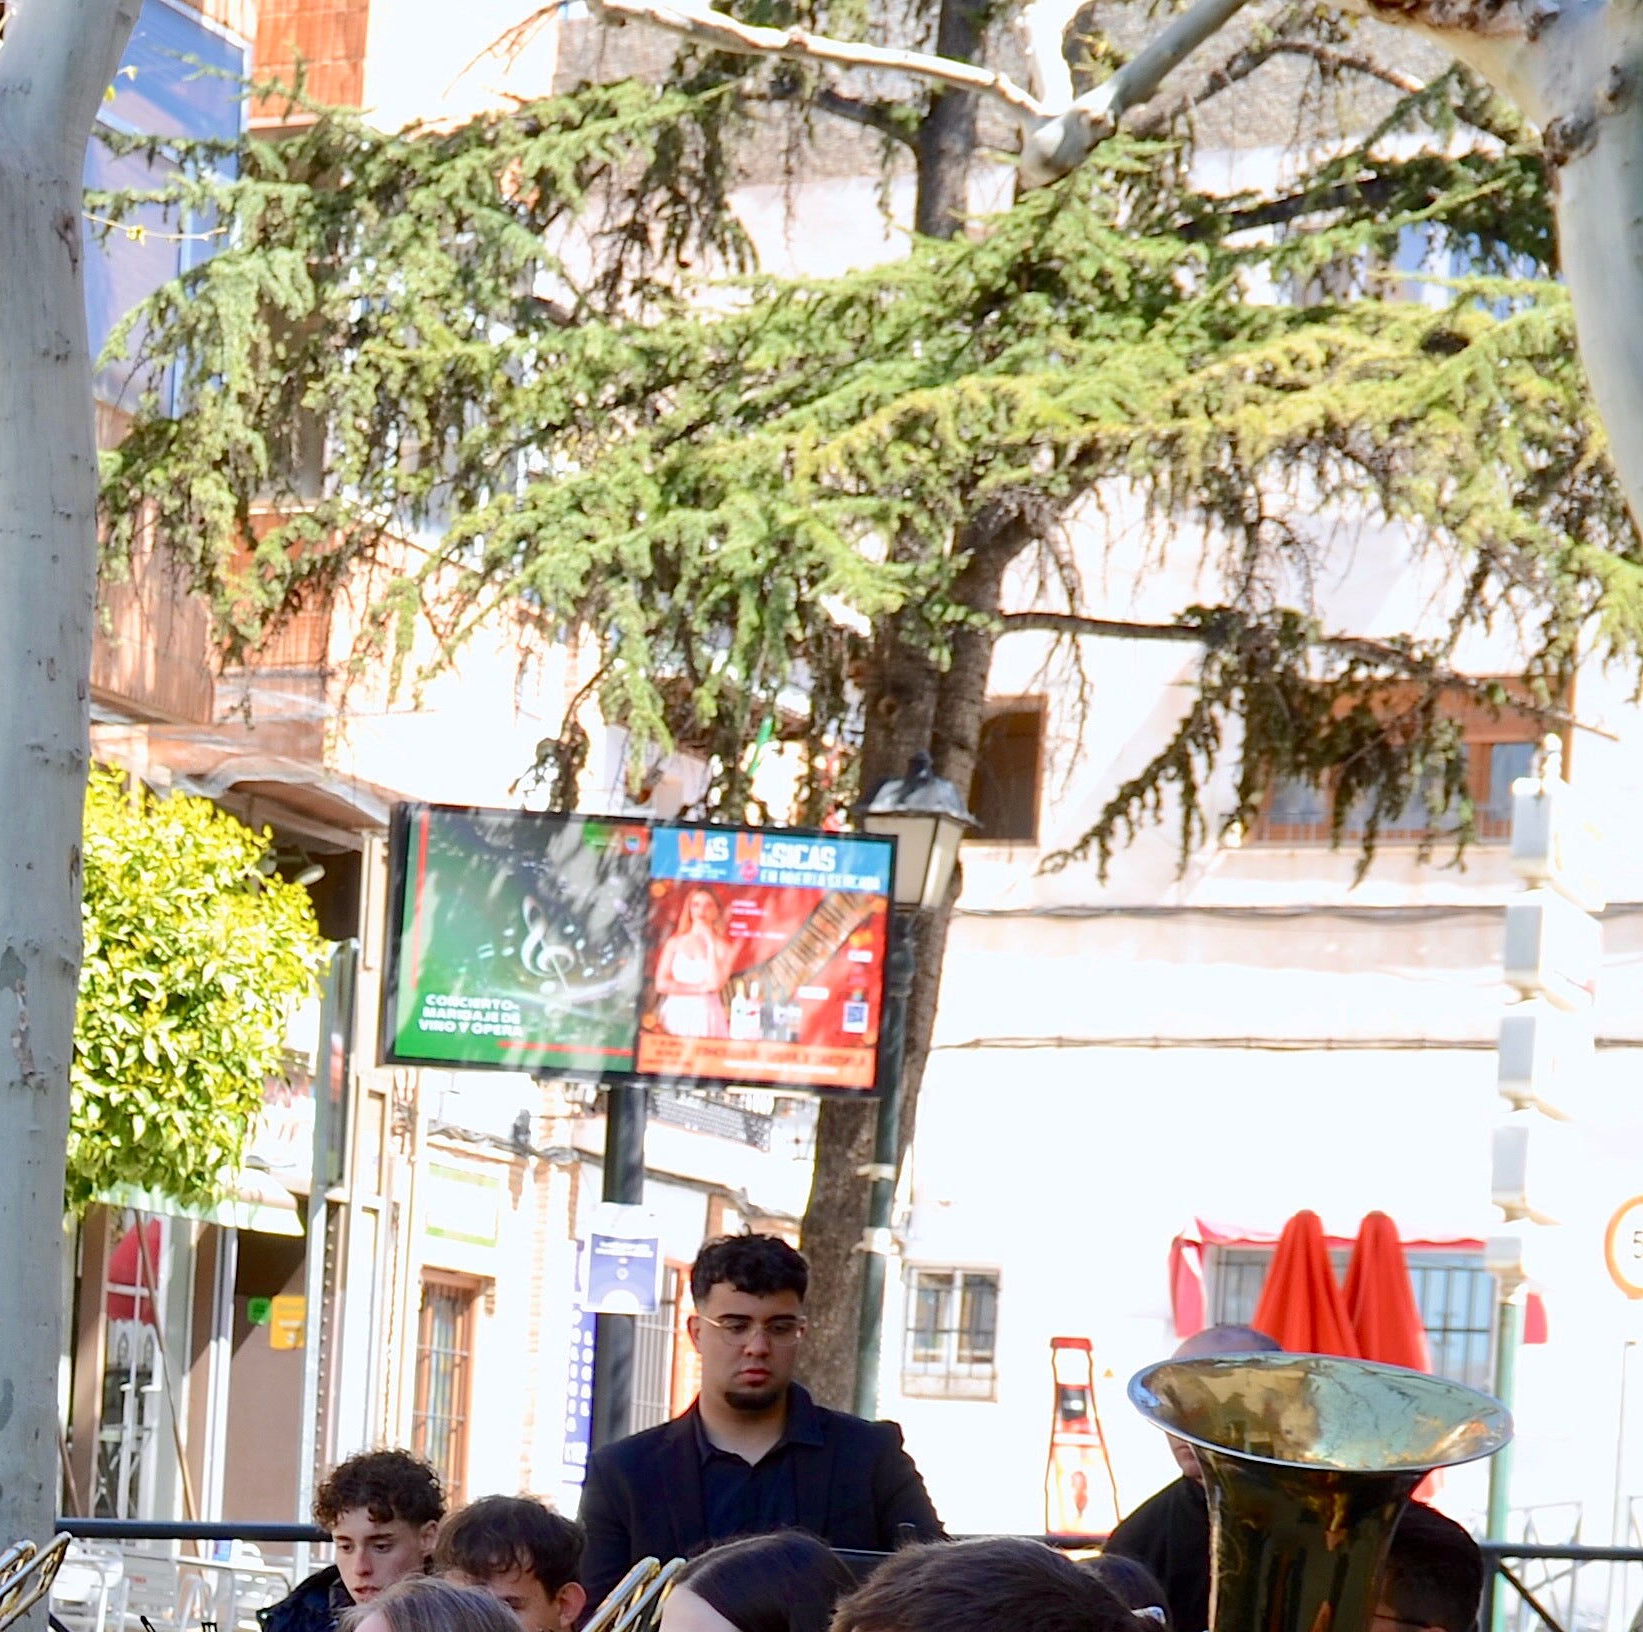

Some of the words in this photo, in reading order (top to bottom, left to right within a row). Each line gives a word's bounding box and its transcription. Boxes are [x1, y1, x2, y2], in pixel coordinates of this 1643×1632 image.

[422, 1006, 500, 1023] MARIDAJE
[501, 1011, 521, 1025] DE
[418, 1019, 457, 1033] VINO
[458, 1021, 470, 1033] Y
